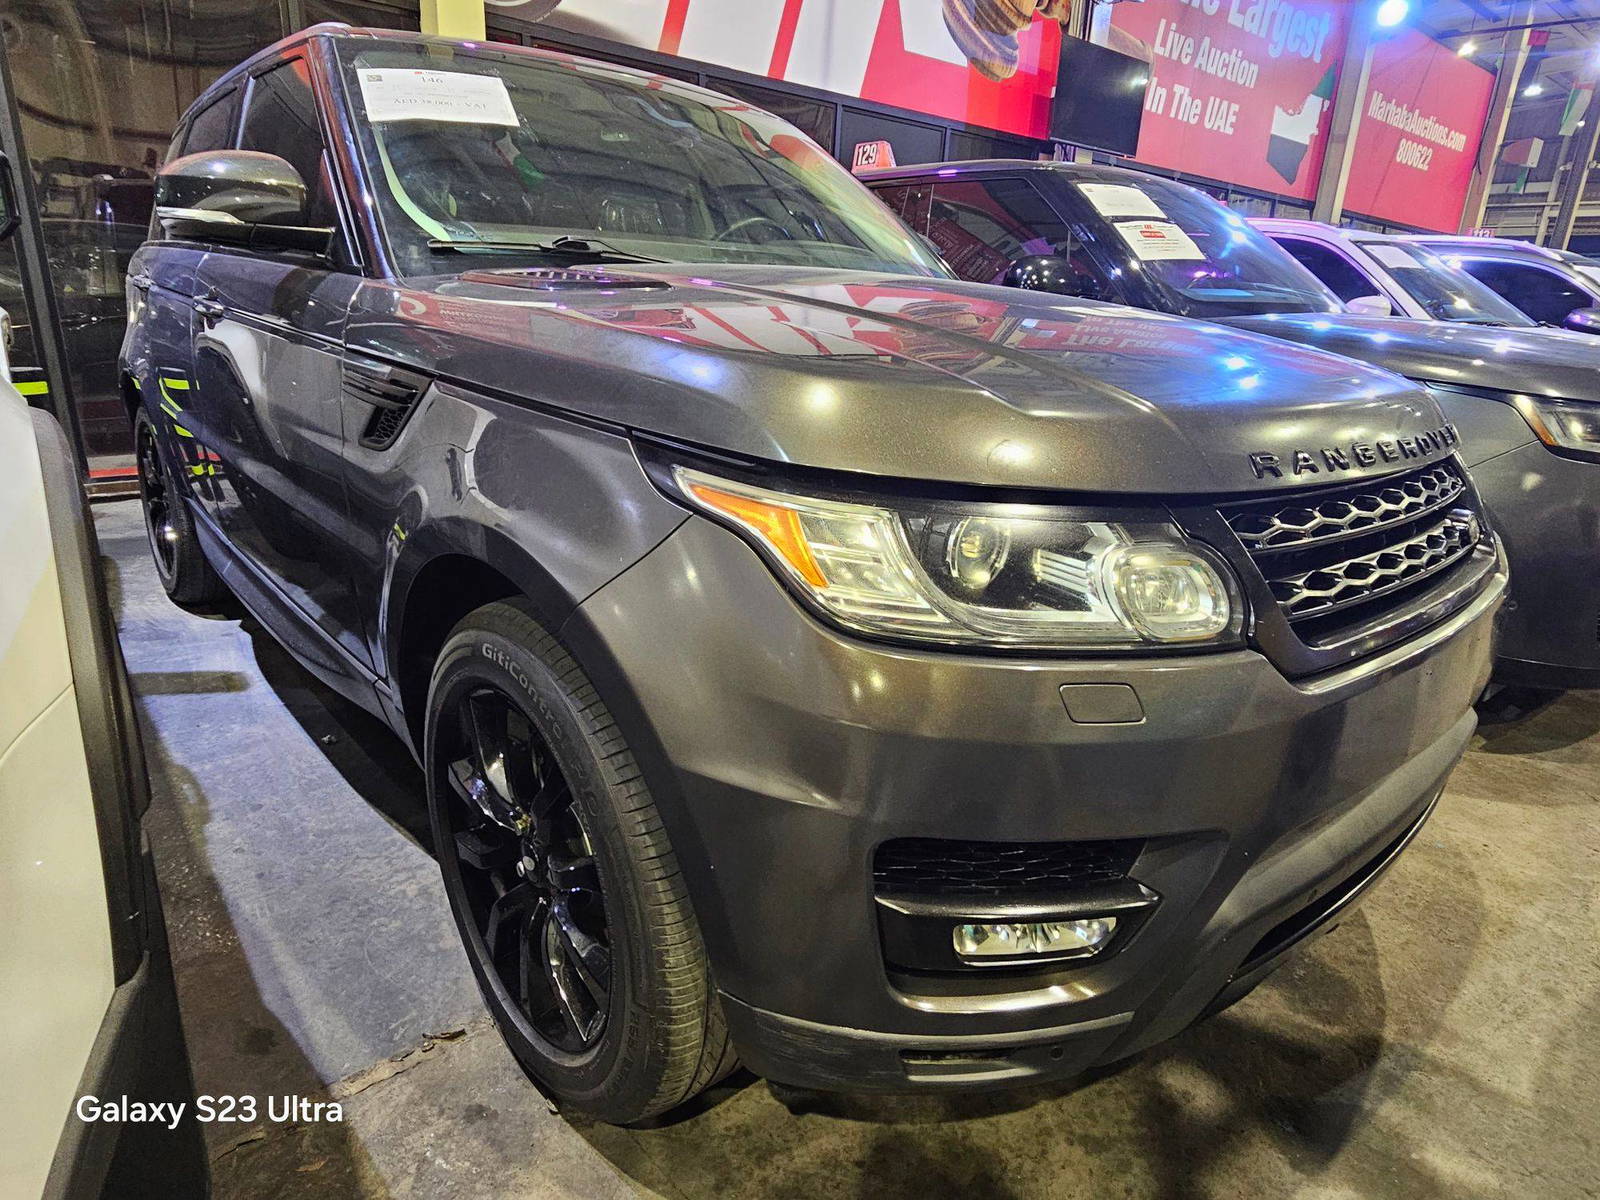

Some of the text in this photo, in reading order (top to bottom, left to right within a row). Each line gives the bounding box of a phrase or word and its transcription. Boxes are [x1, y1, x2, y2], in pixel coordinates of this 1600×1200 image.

[1154, 18, 1259, 88] Live Auction
[1145, 77, 1239, 135] In The UAE
[1368, 90, 1467, 152] MarhabaAuctions.com
[857, 143, 877, 166] 129
[1396, 138, 1433, 171] 800622
[1249, 439, 1400, 479] RANGE
